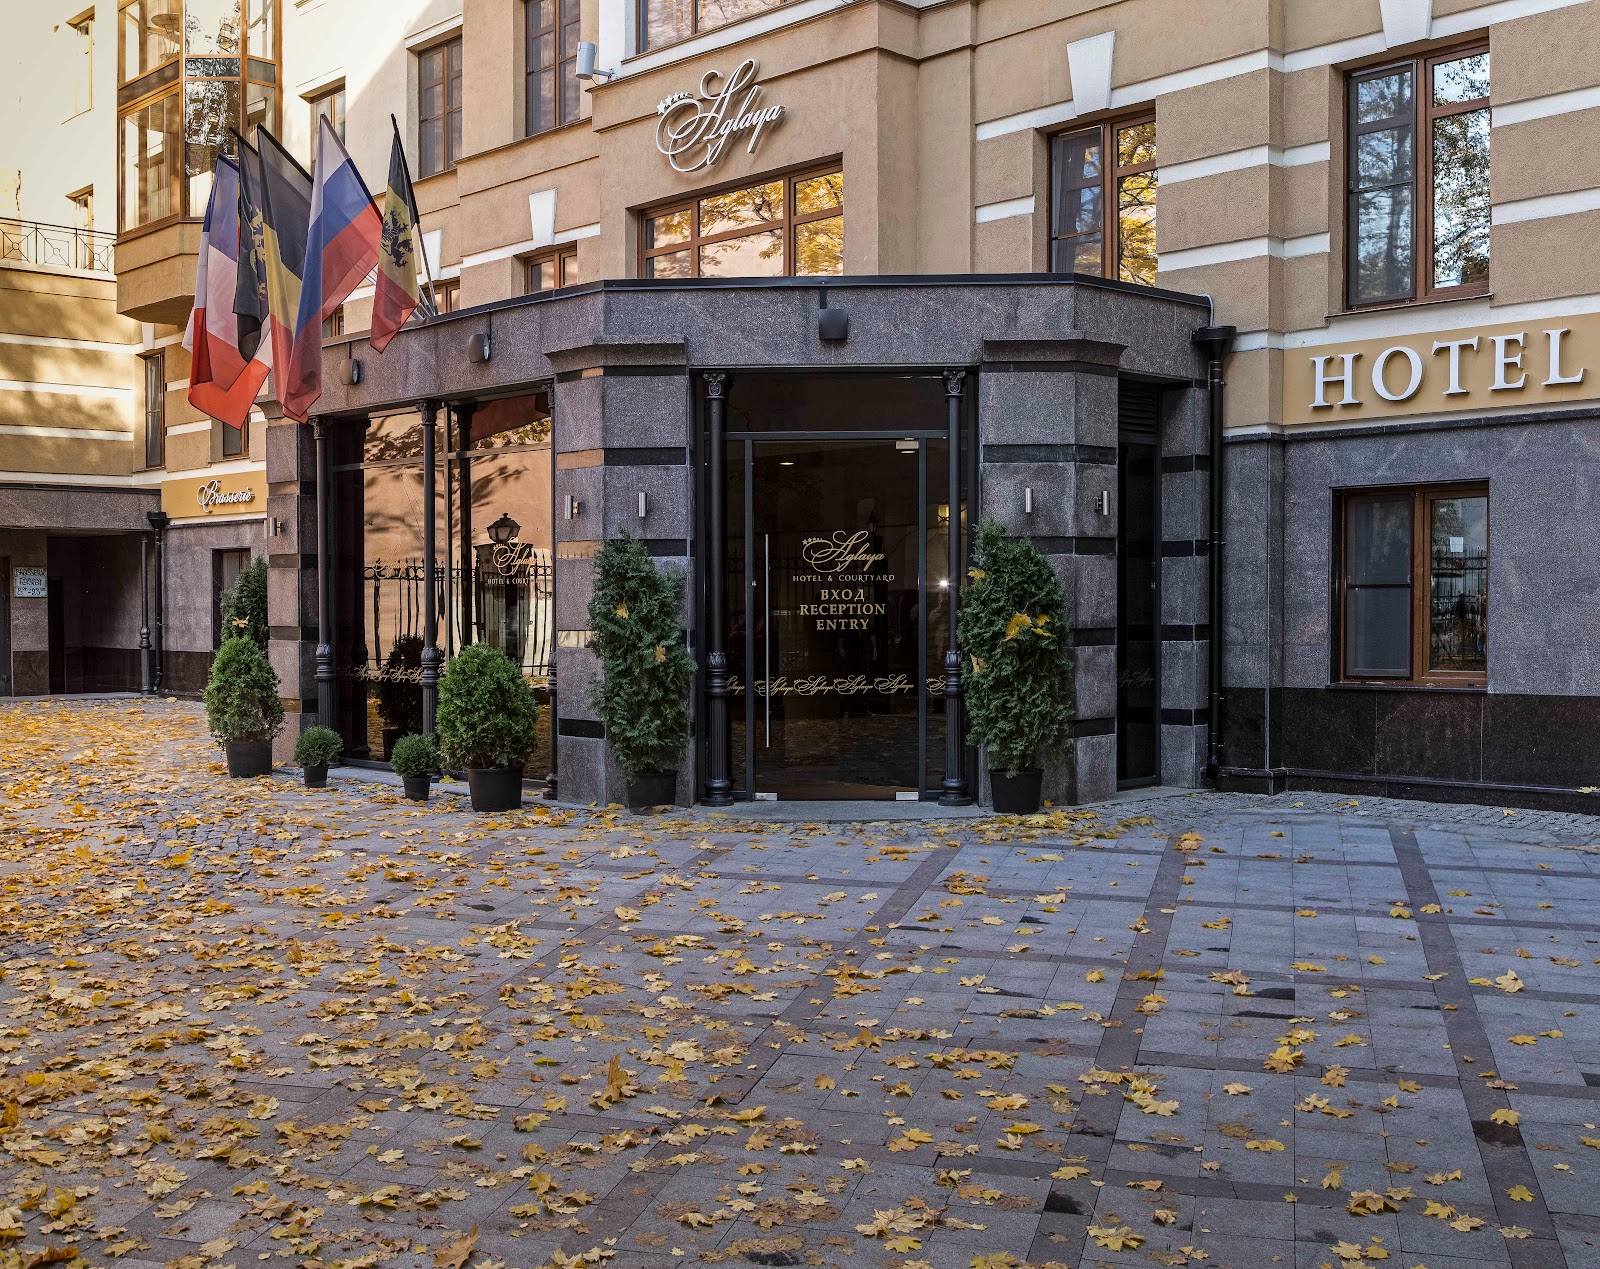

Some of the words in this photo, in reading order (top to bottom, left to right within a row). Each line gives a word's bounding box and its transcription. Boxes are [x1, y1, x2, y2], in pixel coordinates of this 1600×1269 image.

[655, 58, 786, 173] Aglaya
[1308, 328, 1587, 409] HOTEL
[197, 480, 255, 513] Brasserie
[802, 530, 885, 573] Aglaya
[792, 574, 823, 583] HOTEL
[827, 574, 833, 583] &
[838, 574, 895, 583] COURTYARD
[820, 589, 865, 602] ВХОД
[799, 603, 886, 616] RECEPTION
[815, 619, 870, 631] ENTRY
